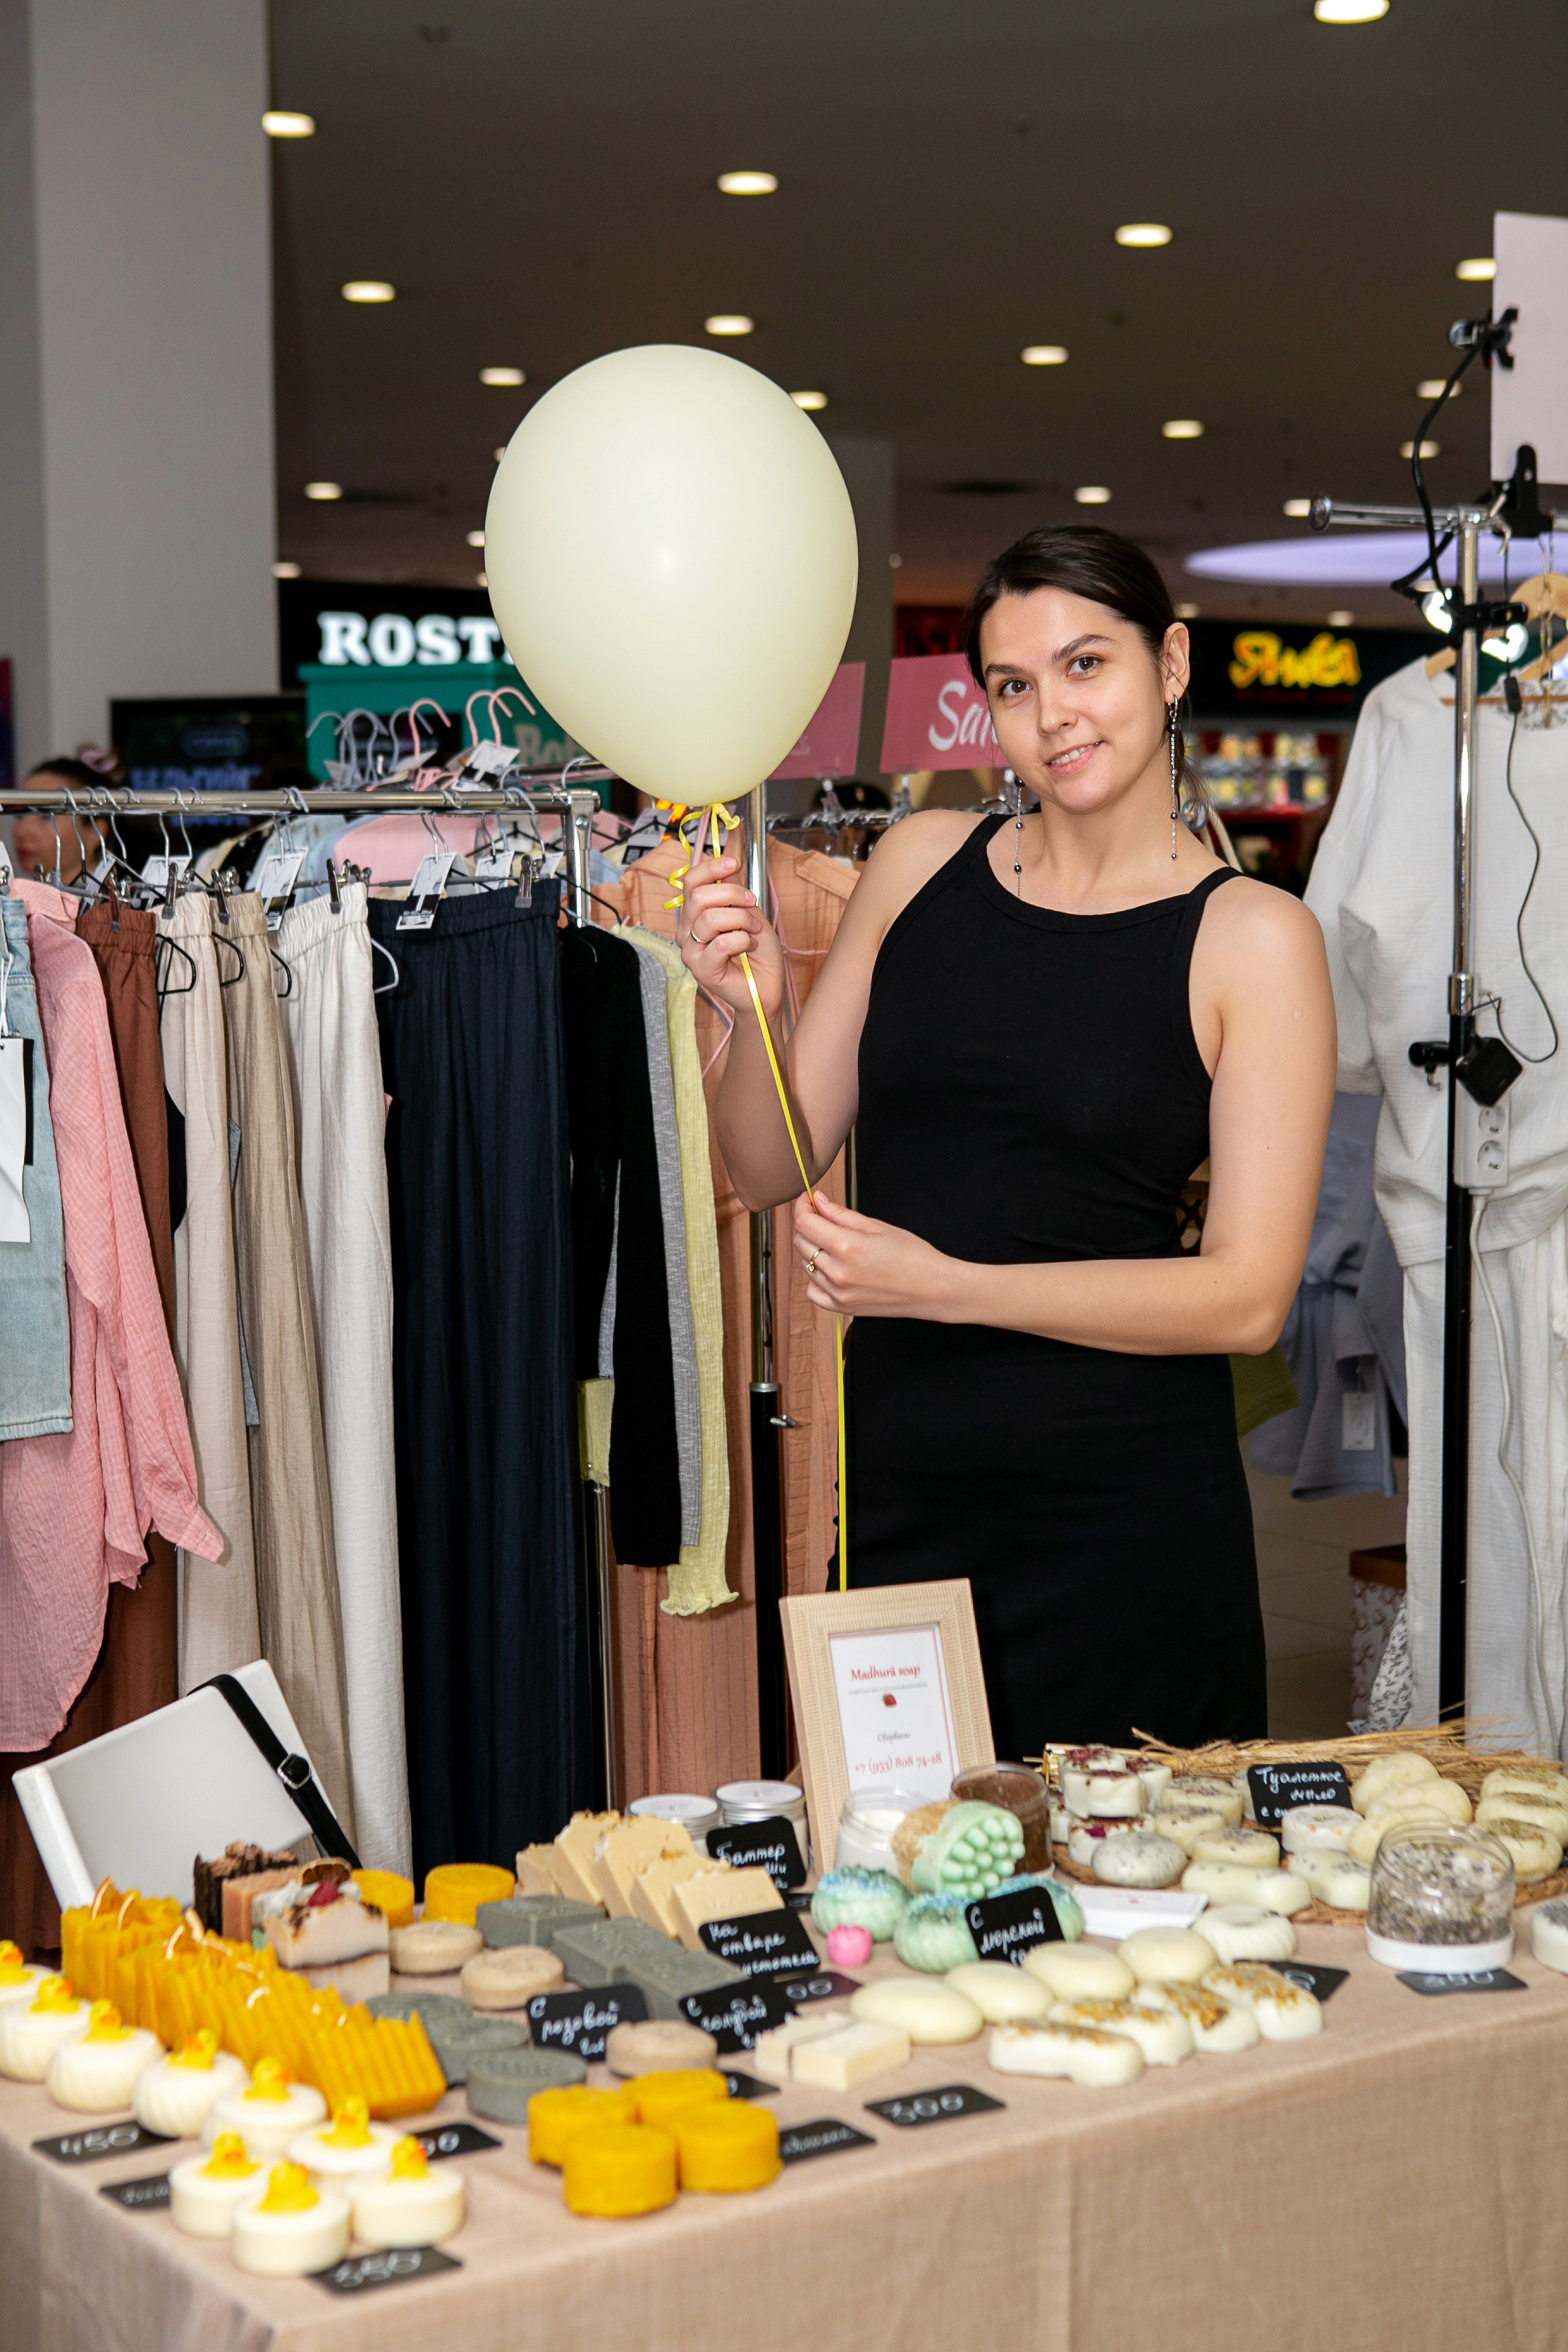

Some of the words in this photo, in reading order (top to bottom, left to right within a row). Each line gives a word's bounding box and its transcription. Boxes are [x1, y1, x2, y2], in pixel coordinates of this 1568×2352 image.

[318, 612, 515, 666] ROST
[899, 1665, 921, 1679] soap
[1255, 1765, 1344, 1794] Туалетное
[980, 1907, 1046, 1955] морской
[541, 1999, 620, 2046] розовой
